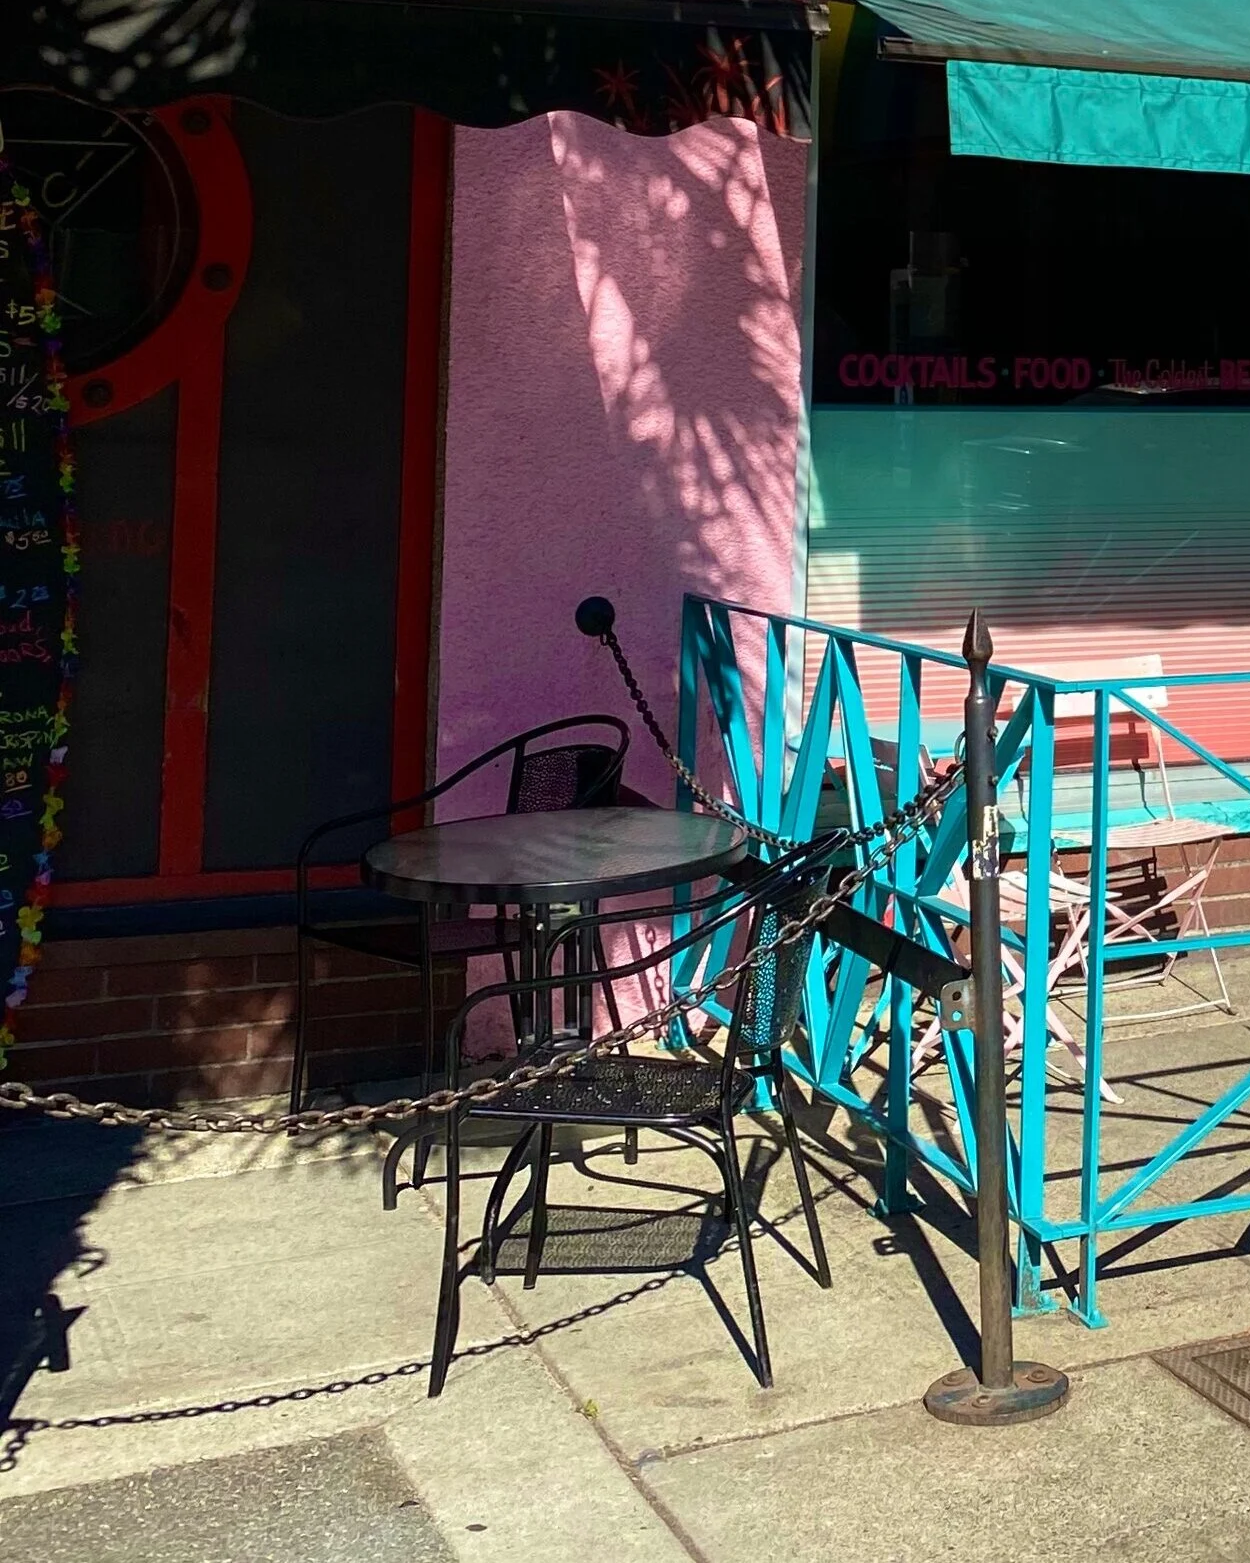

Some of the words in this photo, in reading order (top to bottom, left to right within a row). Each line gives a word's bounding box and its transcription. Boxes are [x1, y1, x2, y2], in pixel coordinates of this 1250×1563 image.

[838, 352, 997, 390] COCKTAILS
[1013, 355, 1092, 390] FOOD
[1106, 357, 1142, 389] The
[1146, 356, 1215, 389] Coldest
